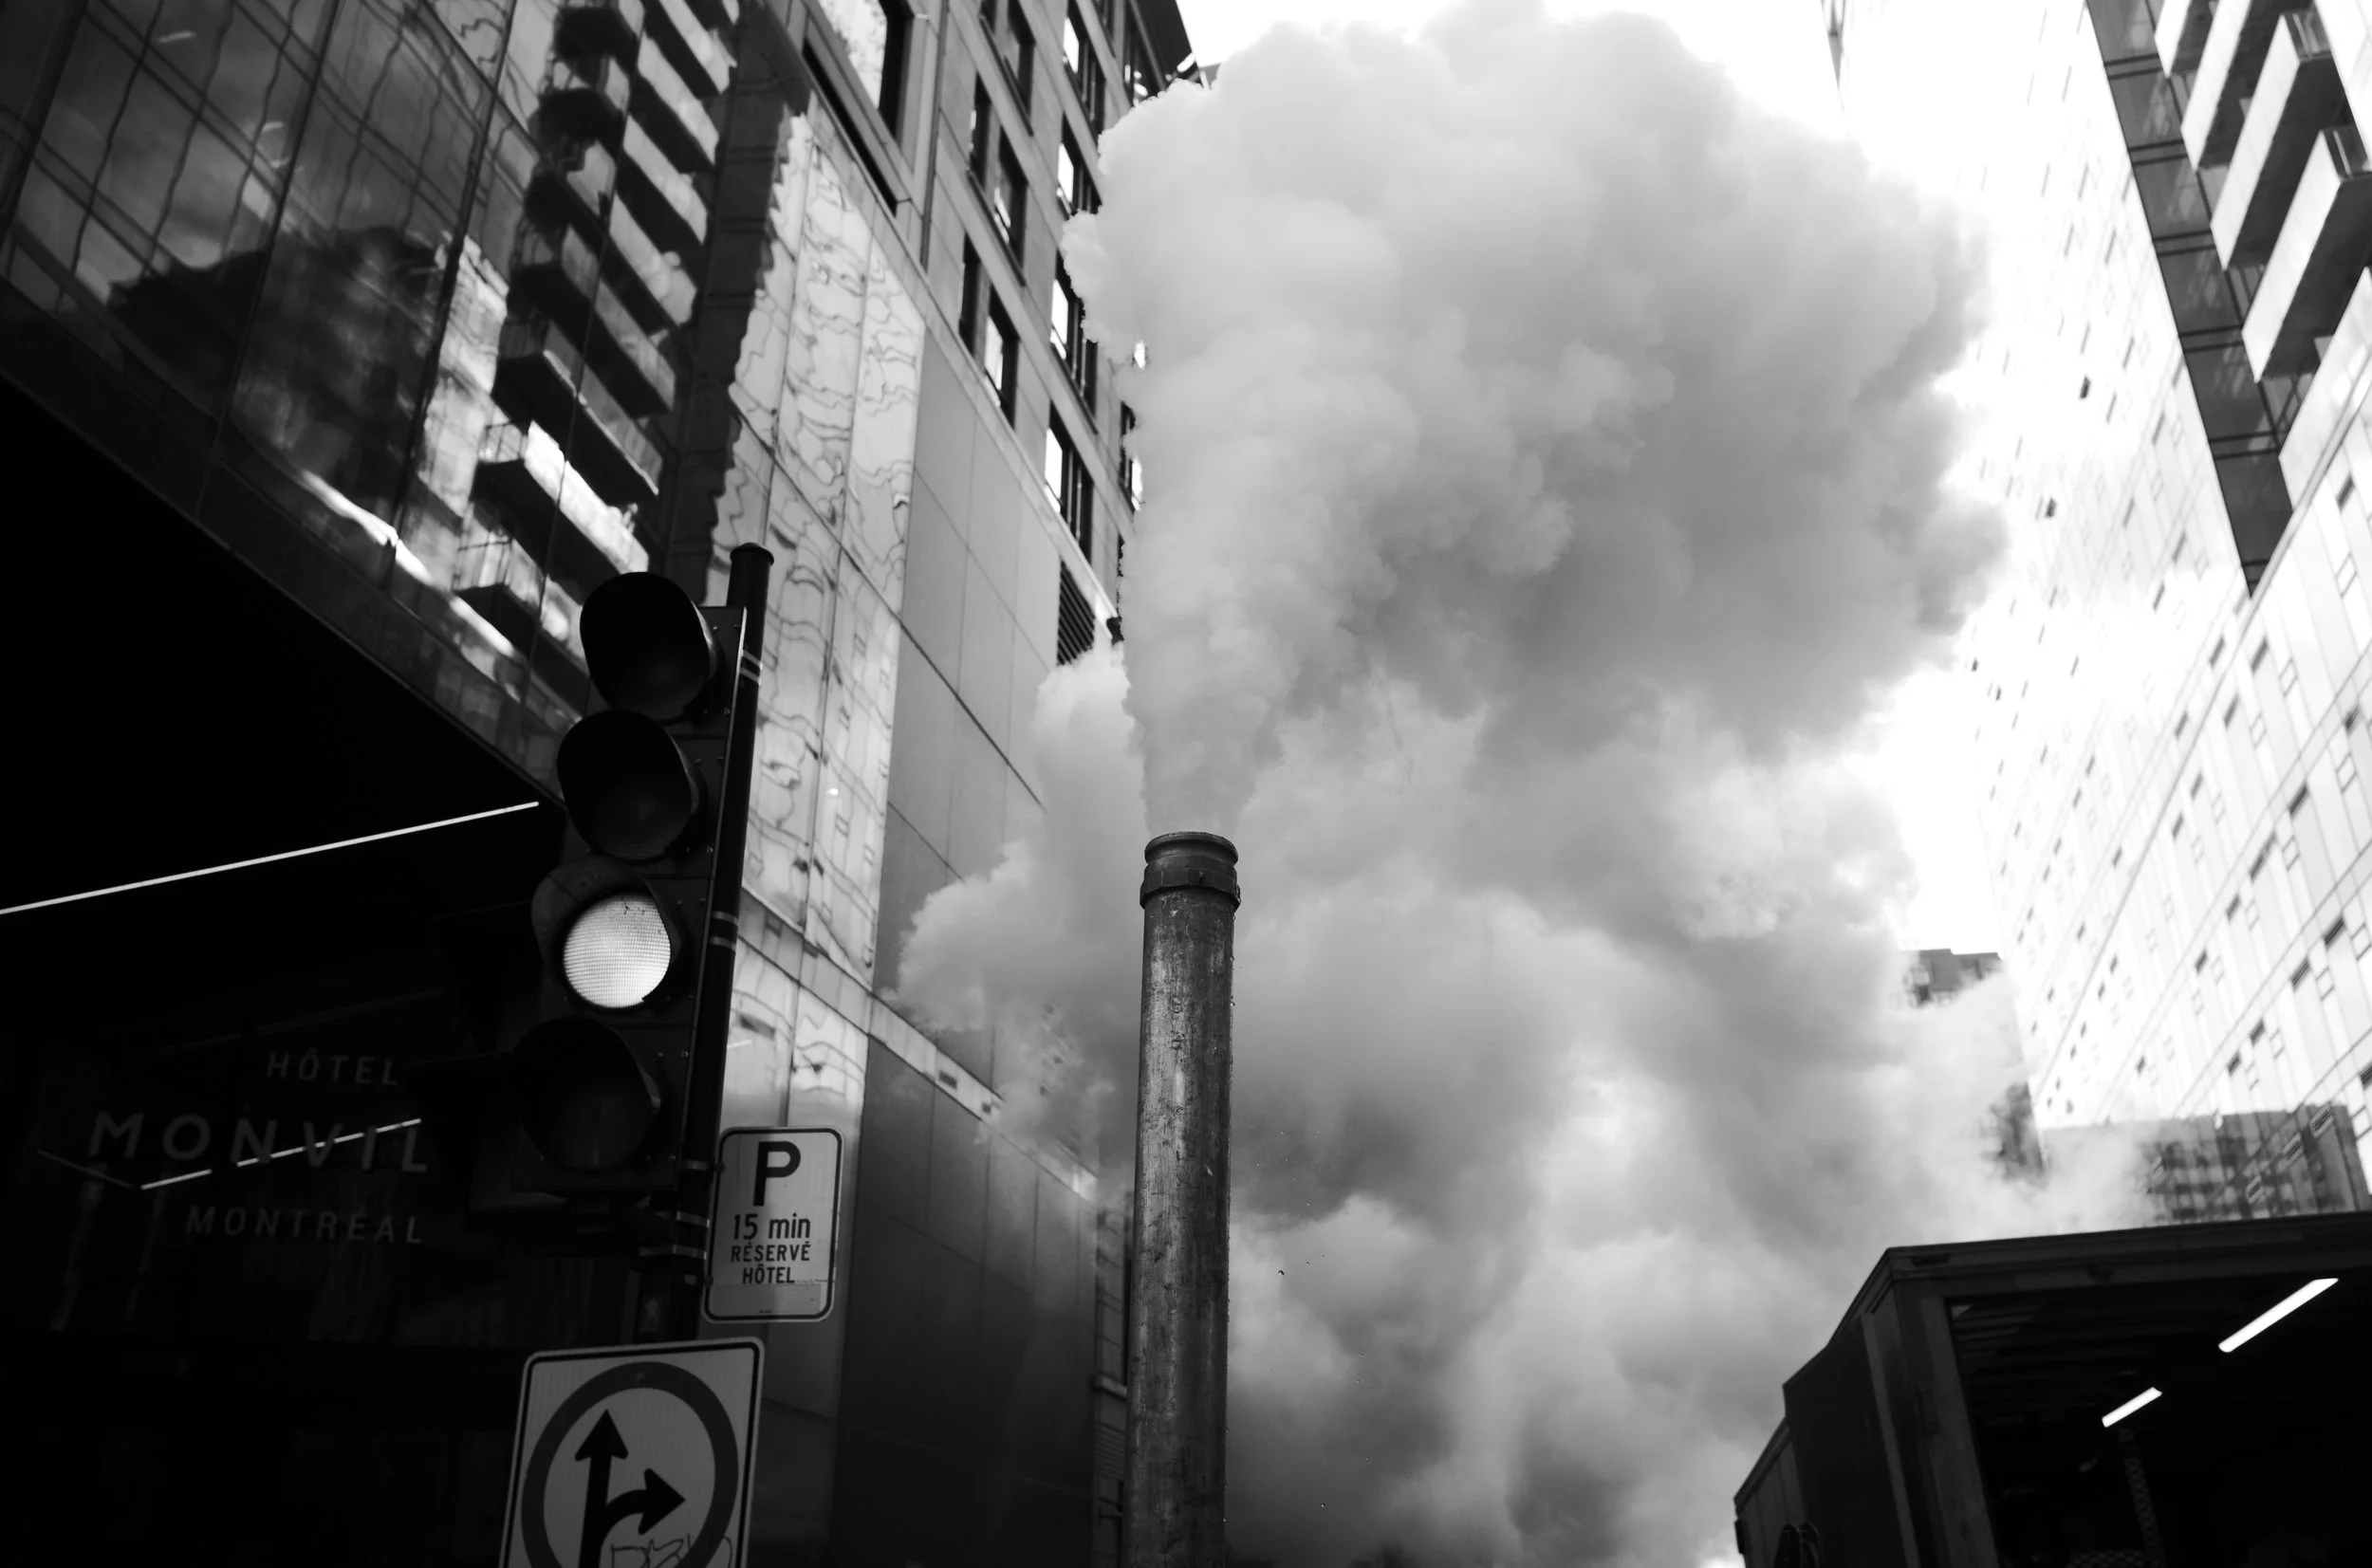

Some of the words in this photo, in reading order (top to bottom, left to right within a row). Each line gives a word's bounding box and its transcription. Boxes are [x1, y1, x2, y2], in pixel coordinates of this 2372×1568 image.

[266, 1047, 398, 1086] HÔTEL
[87, 1110, 429, 1173] MONVIL
[753, 1141, 801, 1206] P
[185, 1205, 422, 1245] MONTRÉAL
[733, 1213, 758, 1240] 15
[769, 1212, 810, 1239] min
[731, 1241, 810, 1263] RÉSERVÉ
[742, 1264, 795, 1284] HÔTEL
